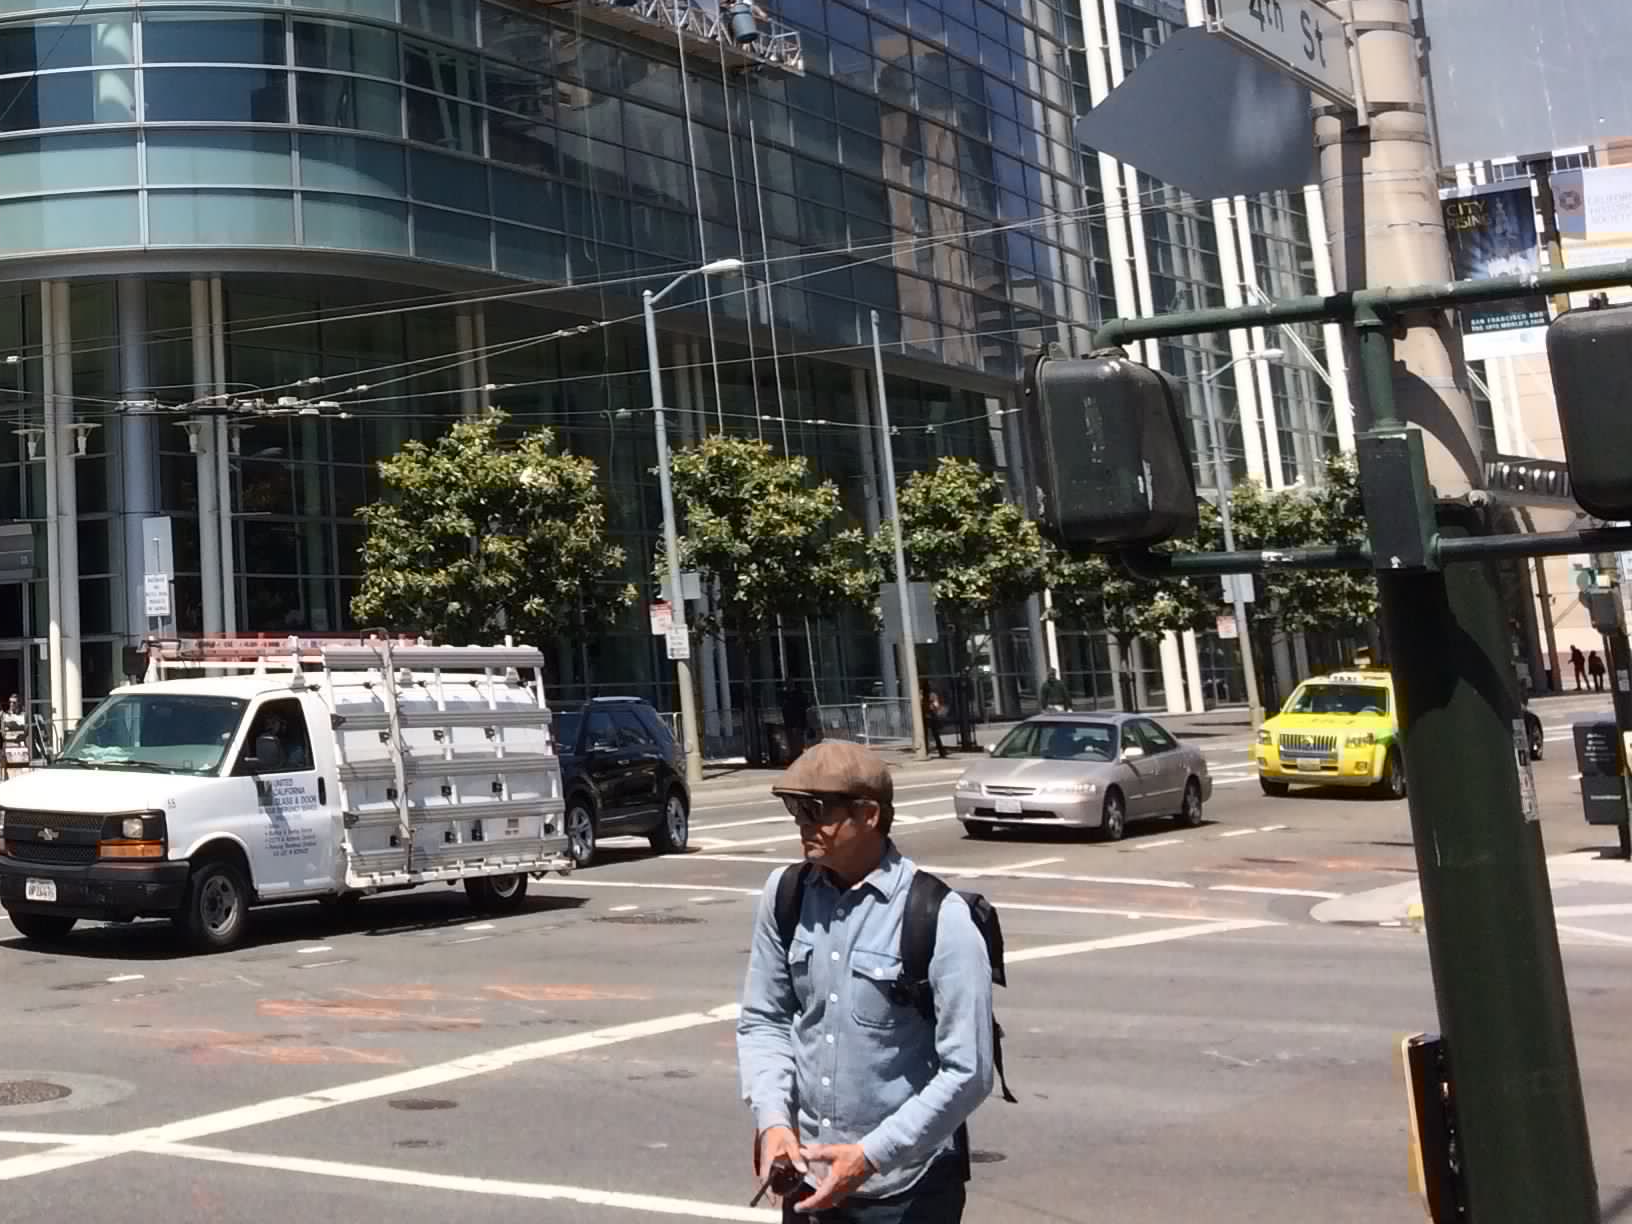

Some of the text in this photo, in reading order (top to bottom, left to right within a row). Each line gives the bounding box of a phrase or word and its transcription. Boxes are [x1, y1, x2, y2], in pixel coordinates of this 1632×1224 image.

[1300, 10, 1326, 68] St
[1446, 200, 1486, 217] CITY
[1447, 215, 1492, 230] RISING
[1487, 313, 1527, 324] FRANCISCO
[272, 786, 305, 796] CALIFORNIA
